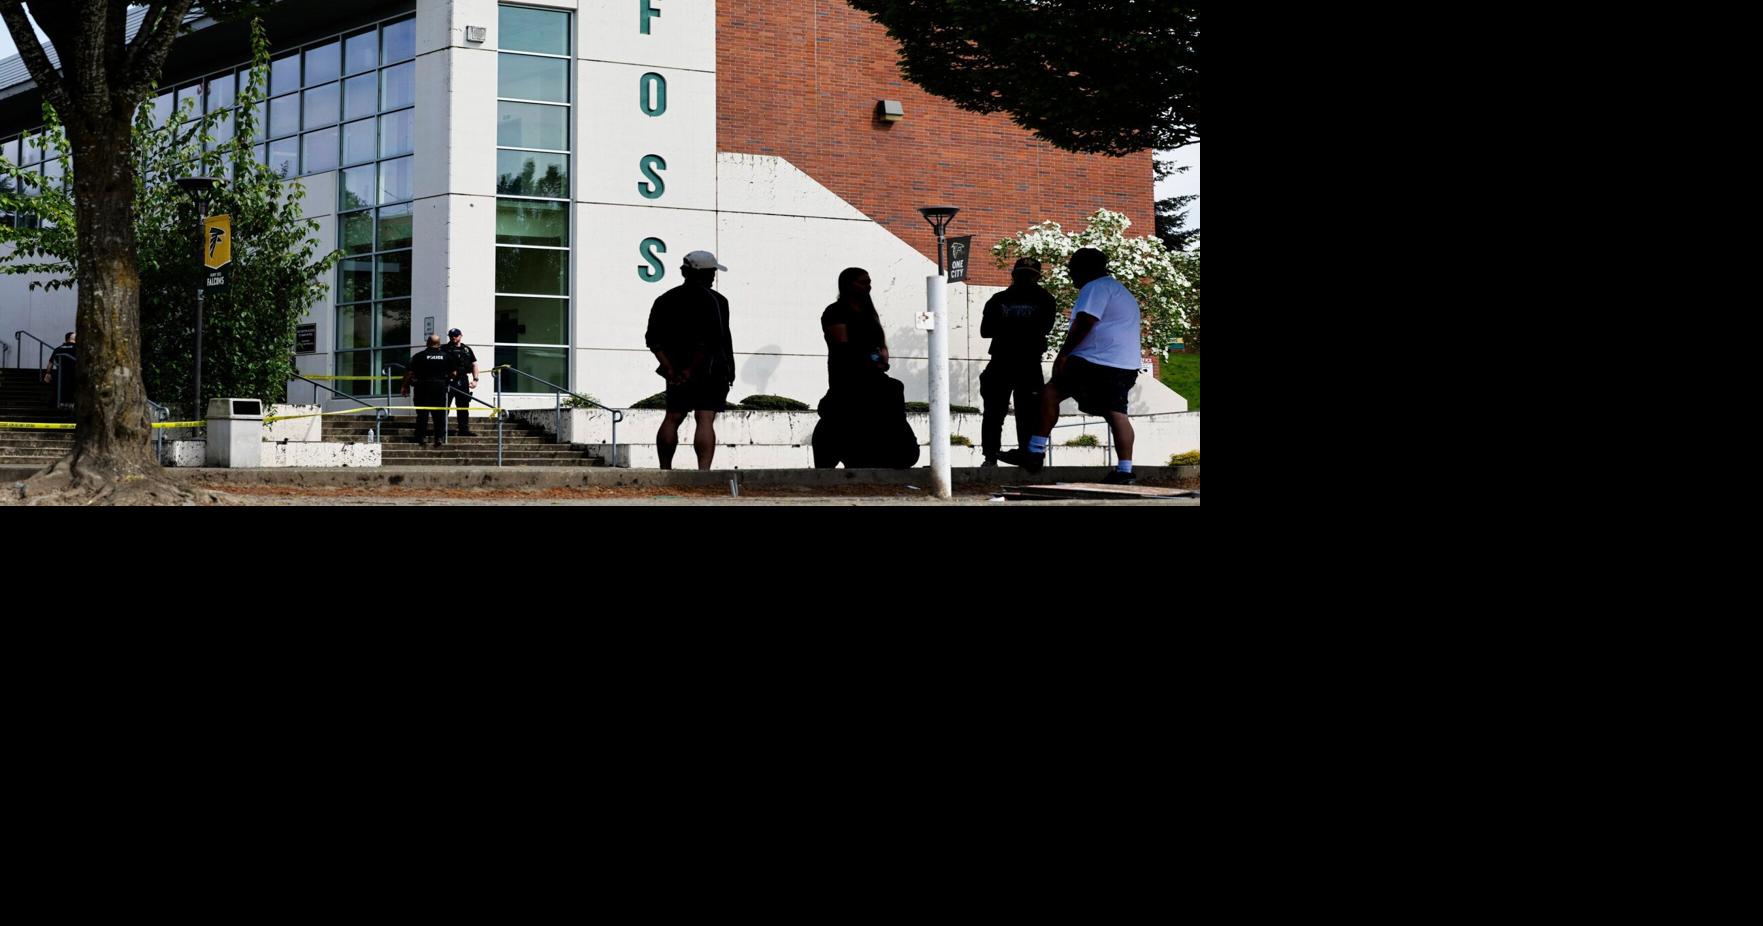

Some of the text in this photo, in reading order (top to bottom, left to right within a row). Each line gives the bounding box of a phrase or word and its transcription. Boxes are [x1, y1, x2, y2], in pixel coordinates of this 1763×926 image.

[638, 0, 667, 283] FOSS
[952, 260, 964, 269] ONE
[951, 269, 964, 278] CITY
[207, 277, 224, 286] FALCONS
